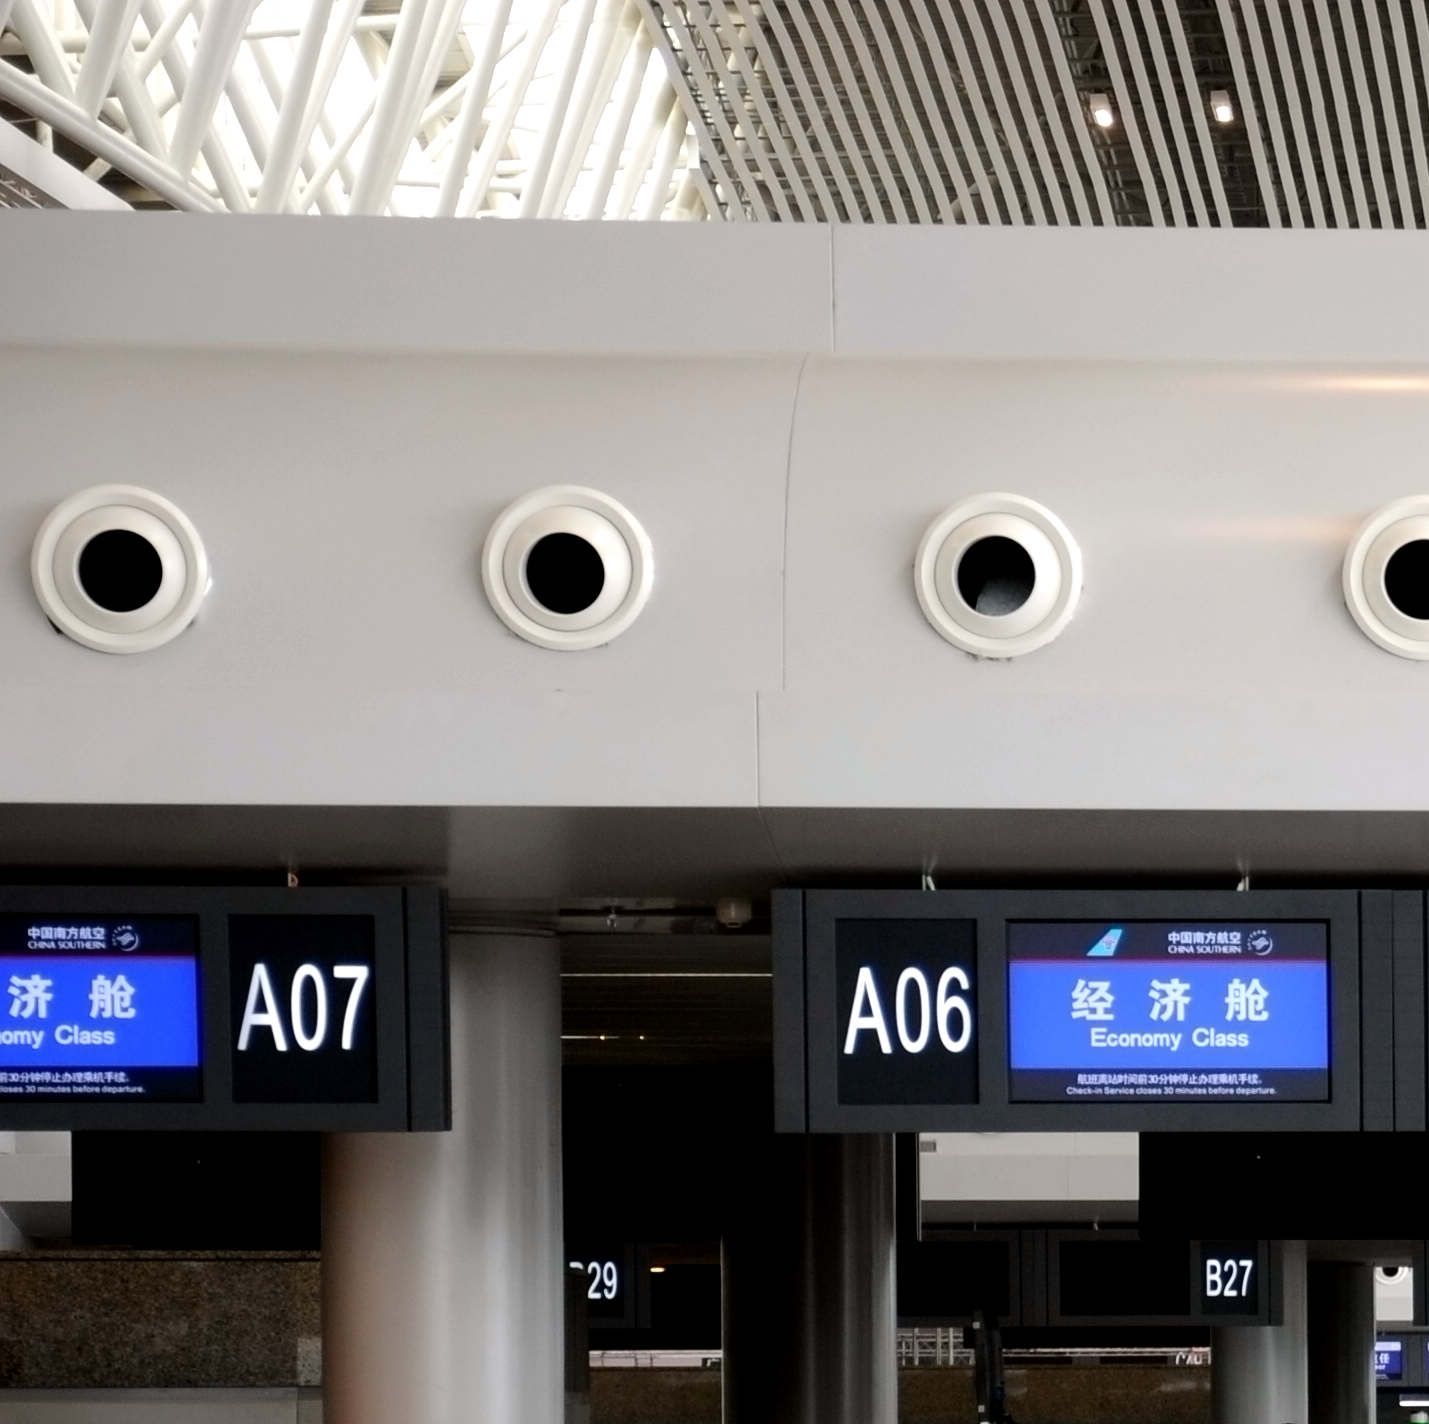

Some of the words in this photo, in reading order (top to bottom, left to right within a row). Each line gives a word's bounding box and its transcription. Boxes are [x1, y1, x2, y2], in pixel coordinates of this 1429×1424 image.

[238, 963, 368, 1051] A07
[844, 967, 971, 1054] A06
[1072, 979, 1269, 1021] 经济舱
[54, 1025, 115, 1045] Class
[1091, 1028, 1181, 1051] Economy
[1192, 1028, 1249, 1047] Class
[27, 1085, 35, 1093] 30
[73, 1085, 99, 1093] before
[570, 1262, 617, 1299] 29
[1207, 1259, 1252, 1296] B27
